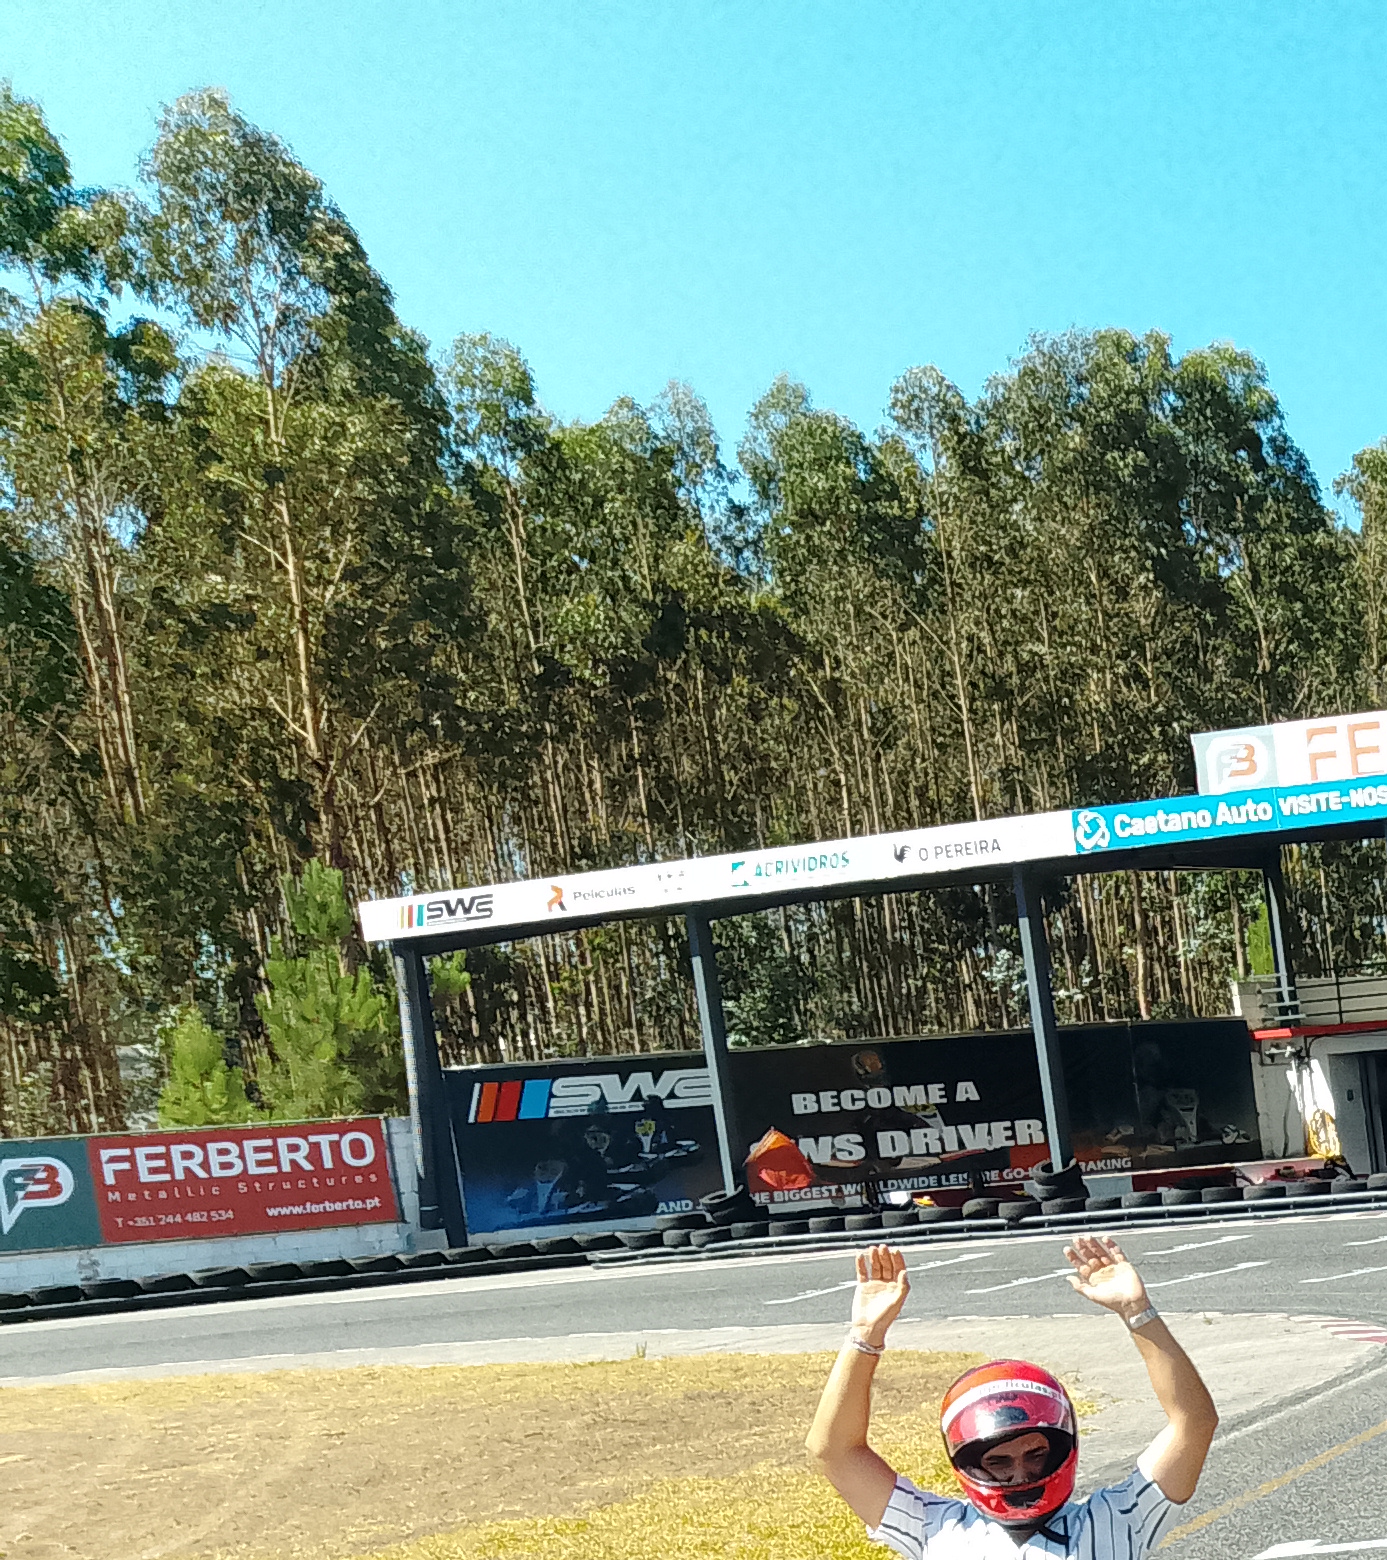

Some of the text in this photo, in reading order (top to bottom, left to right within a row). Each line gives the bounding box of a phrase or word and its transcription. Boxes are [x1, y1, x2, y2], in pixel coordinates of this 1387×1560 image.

[1113, 808, 1211, 838] Caetano
[1215, 800, 1273, 826] Auto
[754, 850, 850, 878] ACRIVIDROS
[918, 838, 1002, 862] O PEREIRA
[426, 893, 494, 921] SWS
[791, 1081, 981, 1115] BECOME A
[750, 1118, 1047, 1165] WS DRIVER
[100, 1131, 376, 1187] FERBERTO
[107, 1173, 379, 1203] Metallic Structures
[773, 1185, 839, 1202] BIGGEST
[265, 1196, 382, 1218] www.ferberto.pt
[655, 1199, 694, 1214] AND
